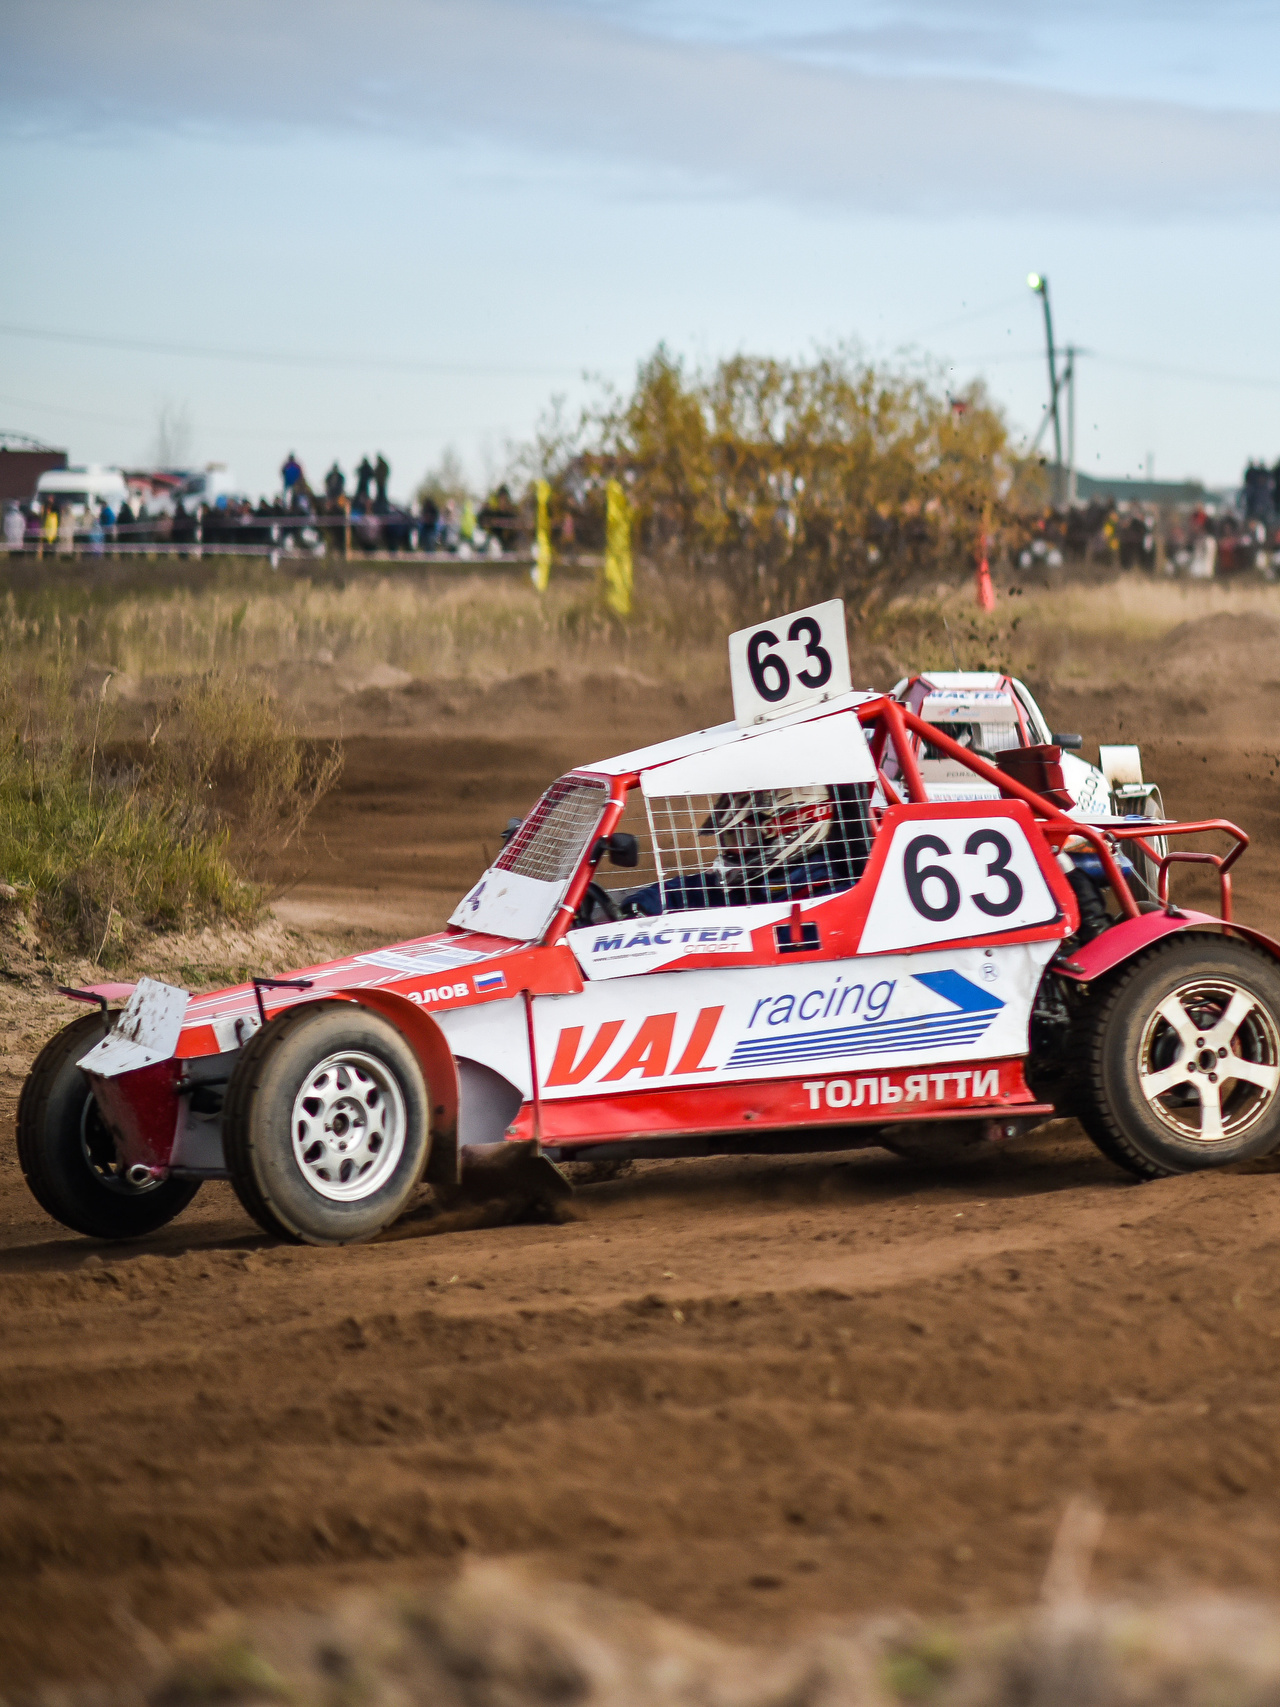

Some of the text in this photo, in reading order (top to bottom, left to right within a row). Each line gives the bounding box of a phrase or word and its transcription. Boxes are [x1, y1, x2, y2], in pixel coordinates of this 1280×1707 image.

[747, 616, 832, 703] 63
[903, 828, 1024, 922] 63
[591, 926, 744, 953] МАСТЕР
[683, 942, 740, 954] СПОРТ
[403, 983, 470, 1006] алов
[542, 976, 898, 1088] VAL racing
[802, 1069, 999, 1110] ТОЛЬЯТТИ
